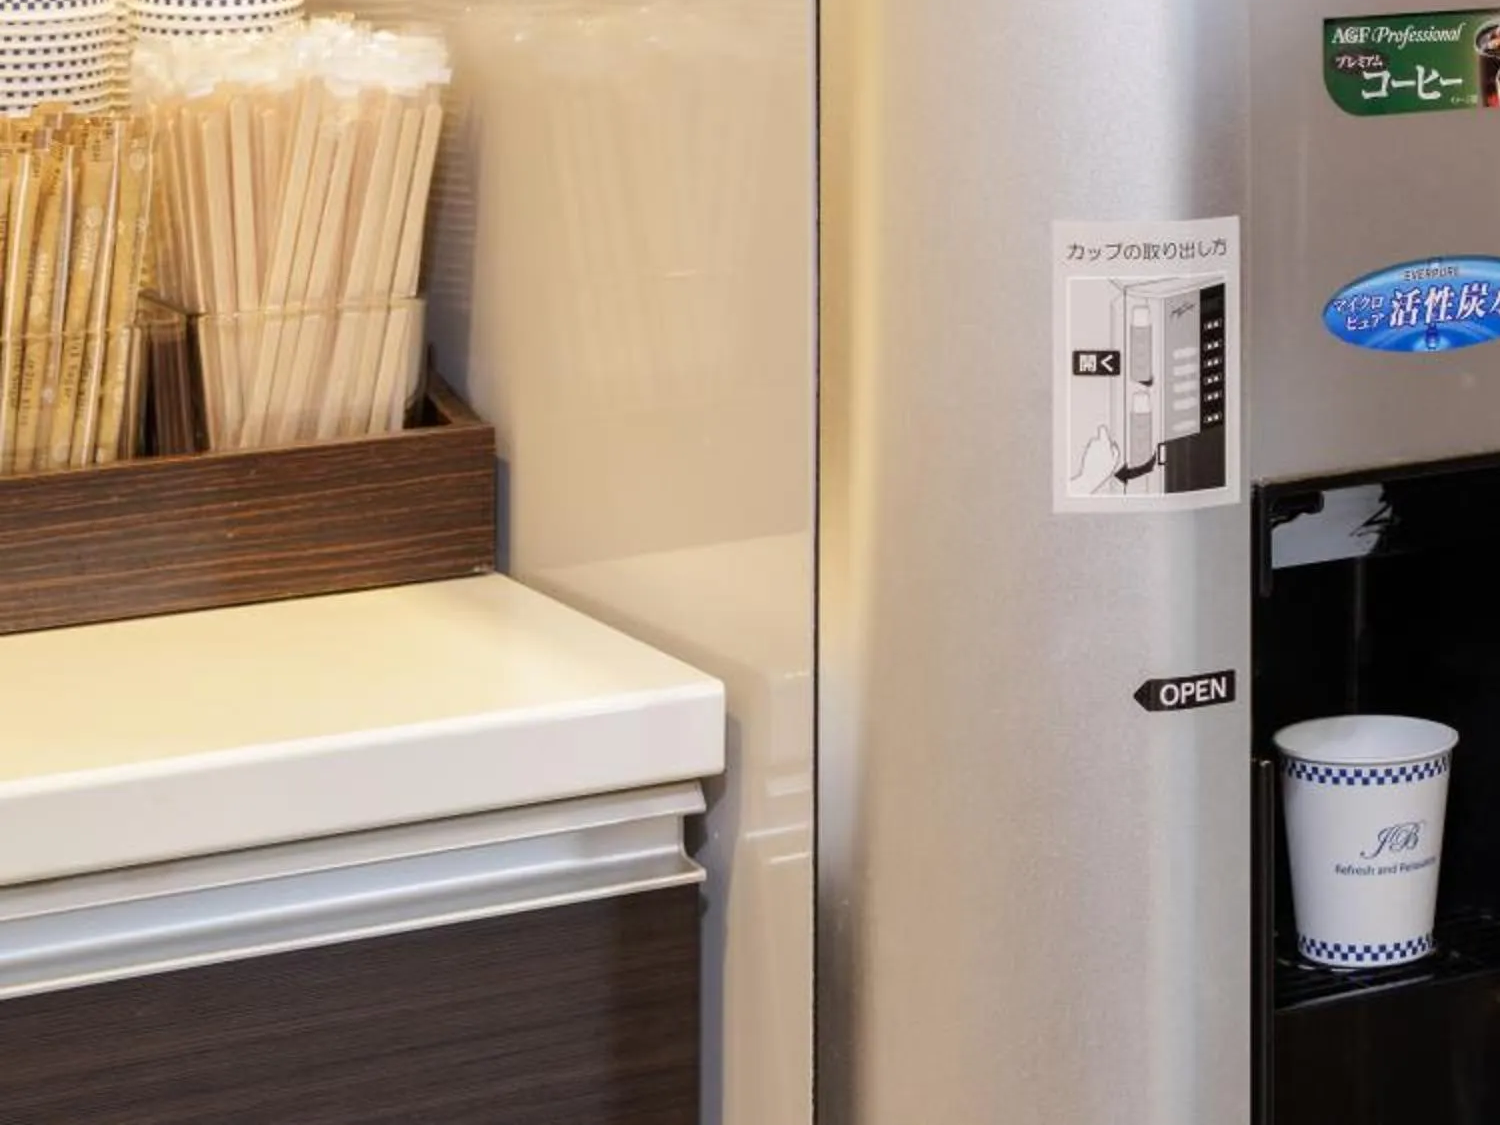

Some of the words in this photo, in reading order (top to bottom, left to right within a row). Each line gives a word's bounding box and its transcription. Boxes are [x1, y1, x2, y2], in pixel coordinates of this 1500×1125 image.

[1332, 26, 1371, 44] AGF
[1371, 22, 1466, 50] Professional
[1336, 55, 1384, 69] プレミアム
[1361, 65, 1463, 100] コーヒー
[1067, 238, 1228, 261] カップの取り出し方
[1334, 296, 1383, 312] マイクロ
[1159, 676, 1228, 707] OPEN
[1377, 863, 1397, 875] and
